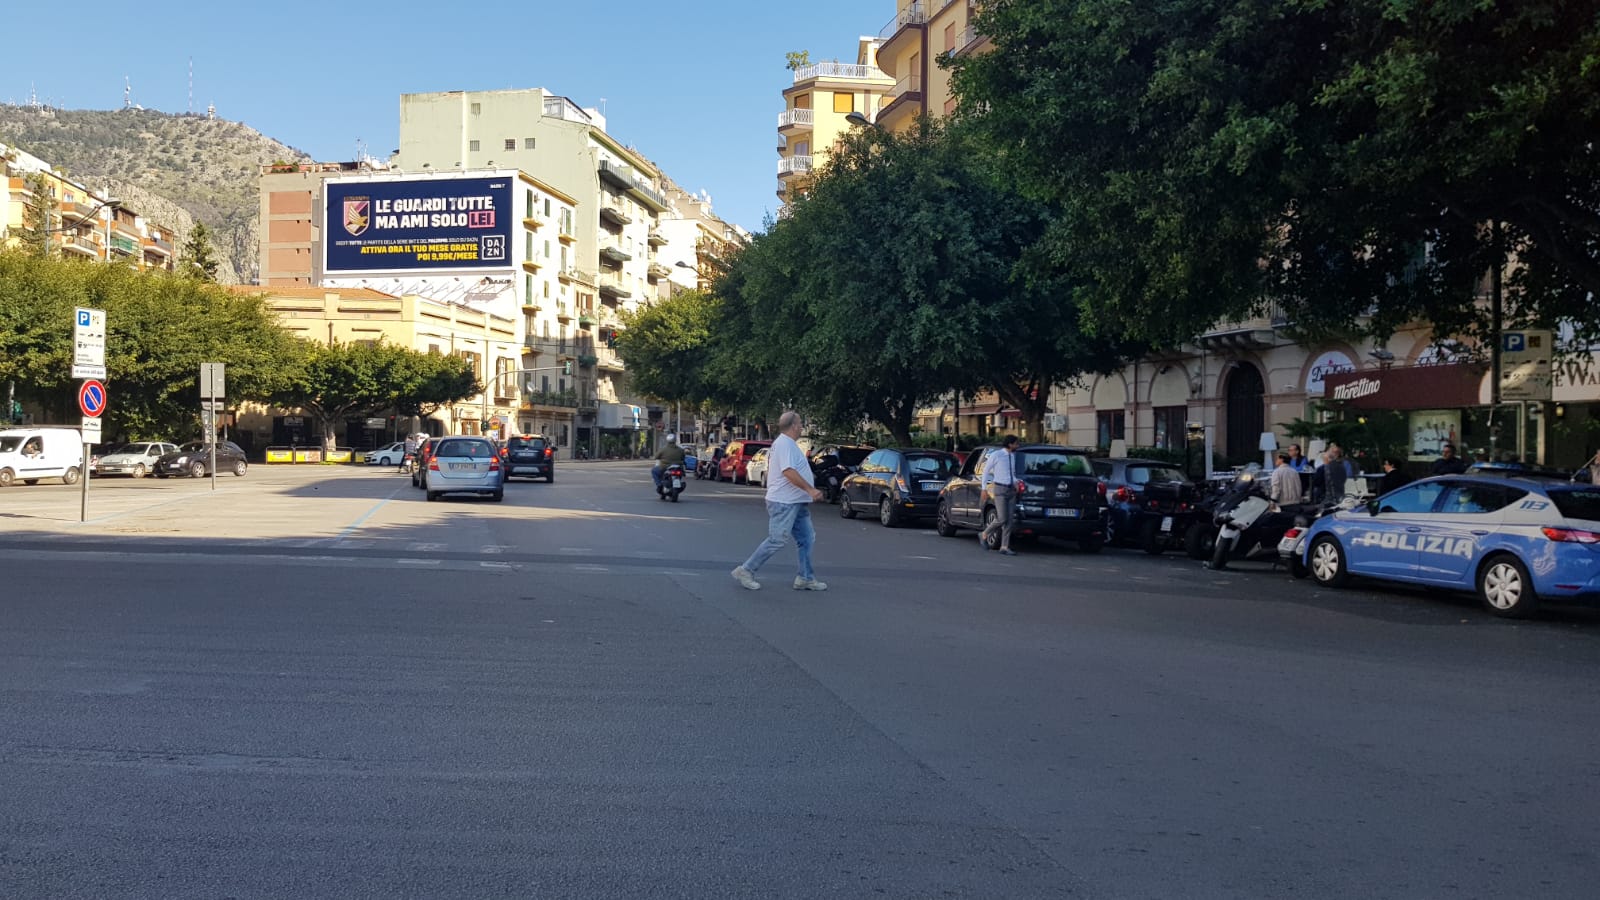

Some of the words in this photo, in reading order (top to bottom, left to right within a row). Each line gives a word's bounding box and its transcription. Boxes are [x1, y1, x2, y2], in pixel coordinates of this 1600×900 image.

[375, 199, 391, 213] LE
[393, 197, 447, 212] GUARDI
[448, 195, 496, 211] TUTTE,
[375, 215, 398, 229] MA
[400, 214, 428, 229] AMI
[431, 213, 468, 228] SOLO
[470, 212, 494, 226] LEI.
[360, 245, 387, 254] ATTIVA
[388, 245, 403, 253] ORA
[405, 245, 411, 253] IL
[428, 244, 450, 252] MESE
[487, 239, 500, 247] DA
[417, 253, 430, 261] POI
[487, 248, 500, 256] ZN
[1508, 336, 1521, 349] P
[1333, 377, 1381, 400] Morettino
[1519, 500, 1549, 511] 113
[1364, 531, 1473, 560] POLIZIA
